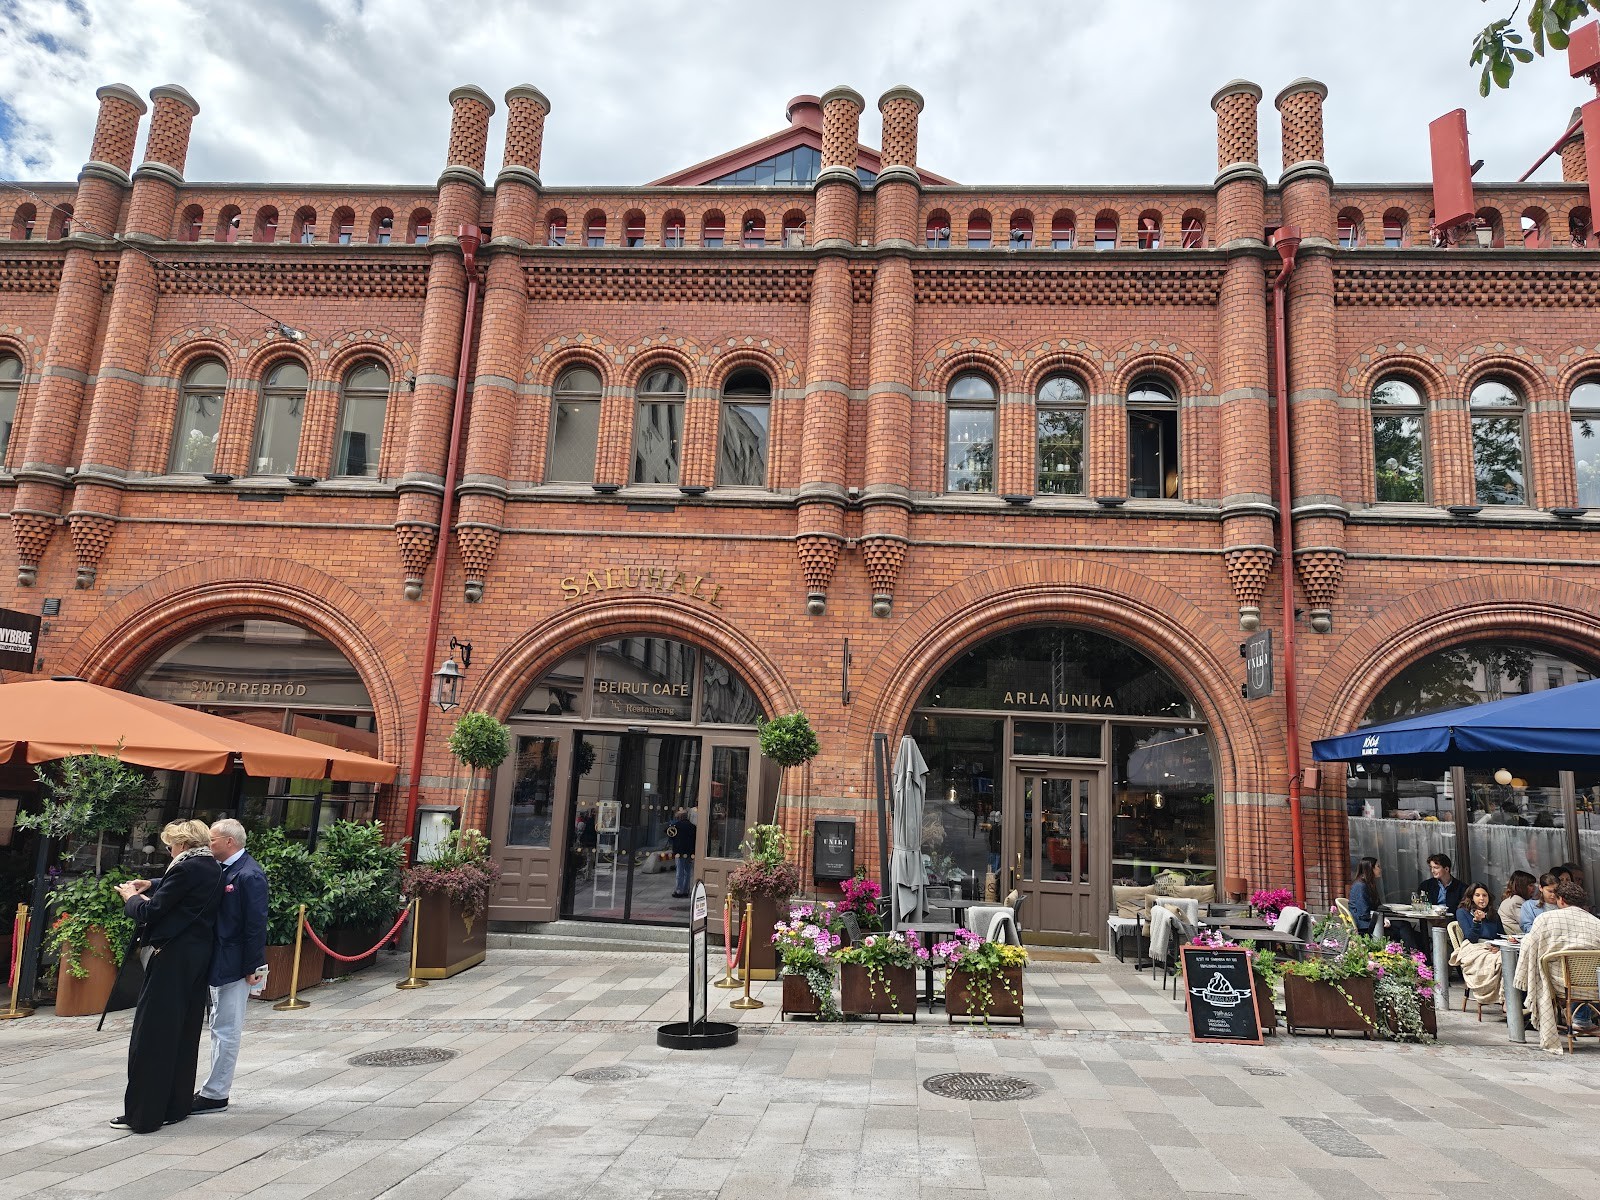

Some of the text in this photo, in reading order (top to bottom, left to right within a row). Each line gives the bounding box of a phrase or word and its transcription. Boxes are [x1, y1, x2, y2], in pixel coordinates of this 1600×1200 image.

[560, 565, 724, 610] SALUHALL
[0, 627, 32, 645] NYBROE
[191, 679, 307, 696] SMÖRREBRÖD
[599, 681, 689, 697] BEIRUT CAFÉ
[1003, 691, 1115, 708] ARLA UNIKA
[626, 703, 675, 716] Restaurang
[1362, 735, 1380, 748] 1664
